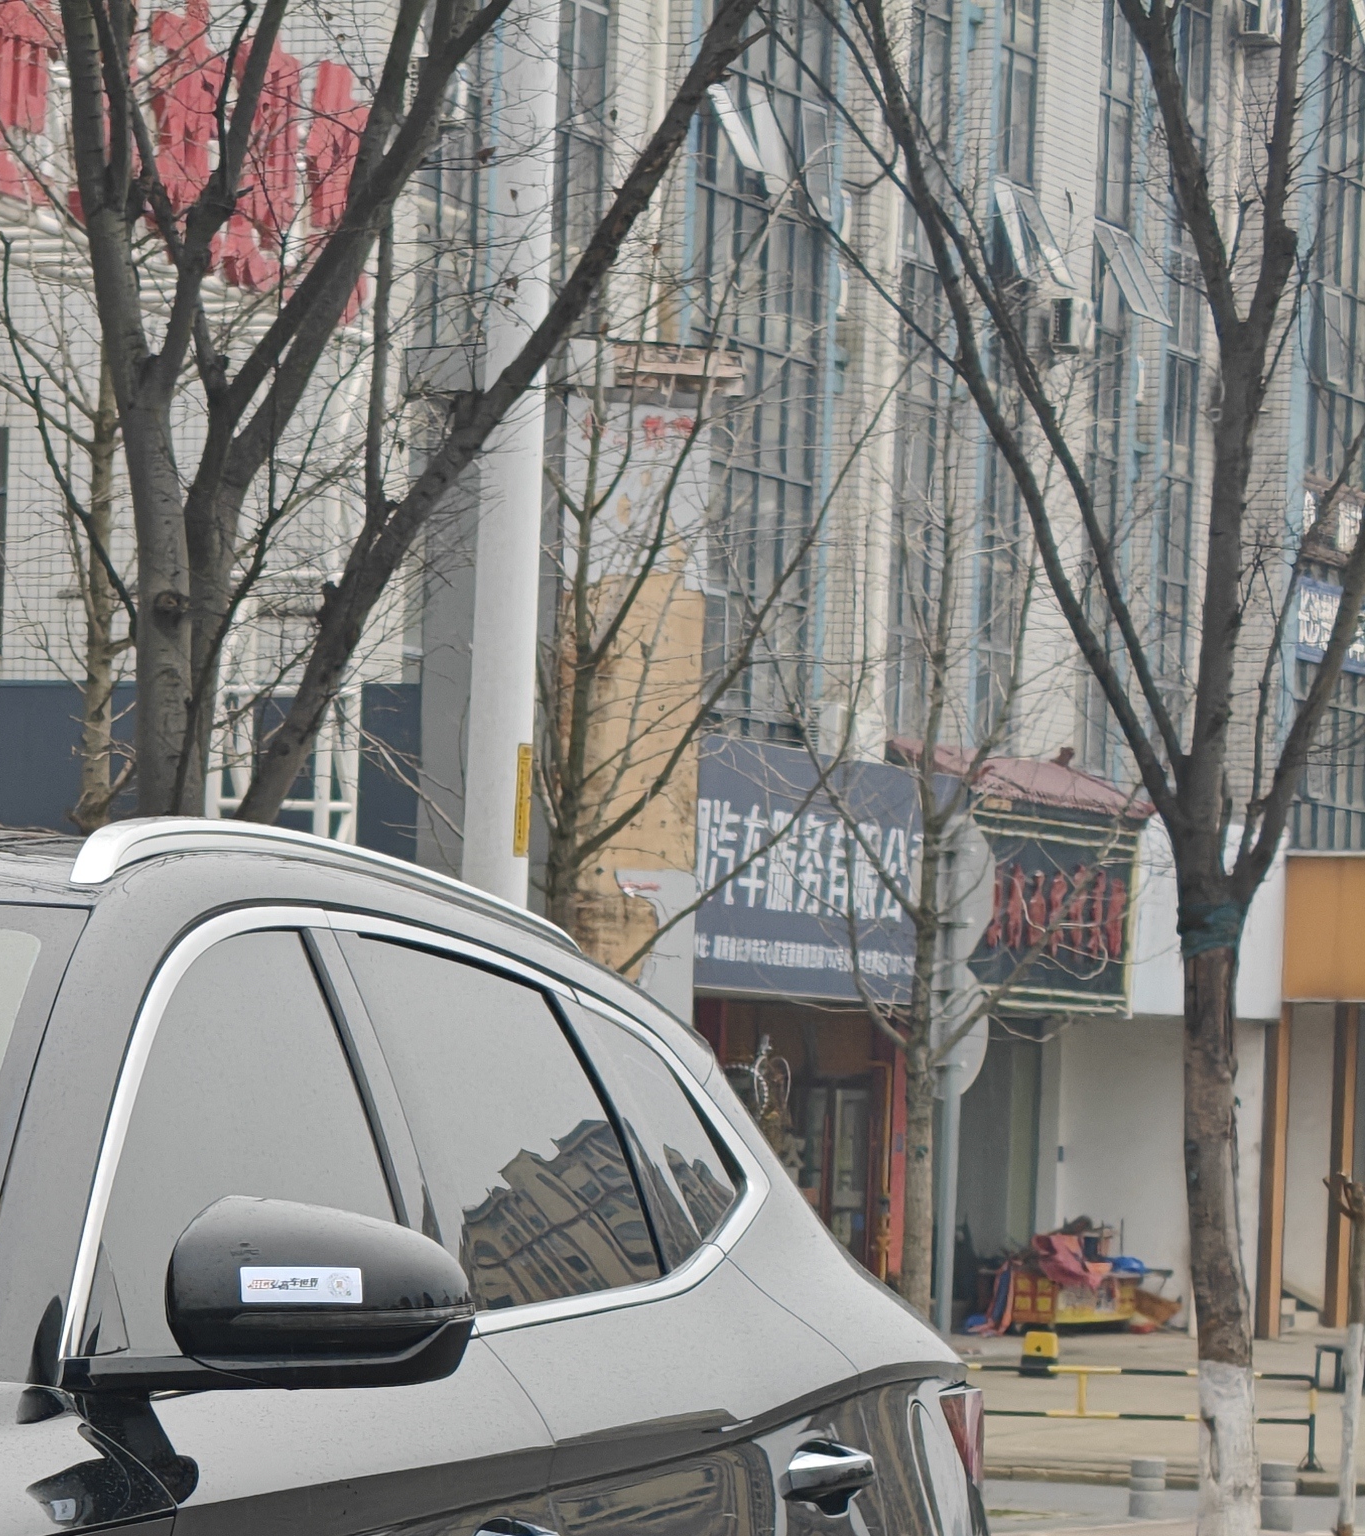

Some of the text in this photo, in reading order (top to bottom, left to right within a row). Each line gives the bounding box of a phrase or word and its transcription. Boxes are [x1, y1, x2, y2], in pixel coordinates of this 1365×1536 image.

[696, 798, 925, 923] 汽车服务有限公
